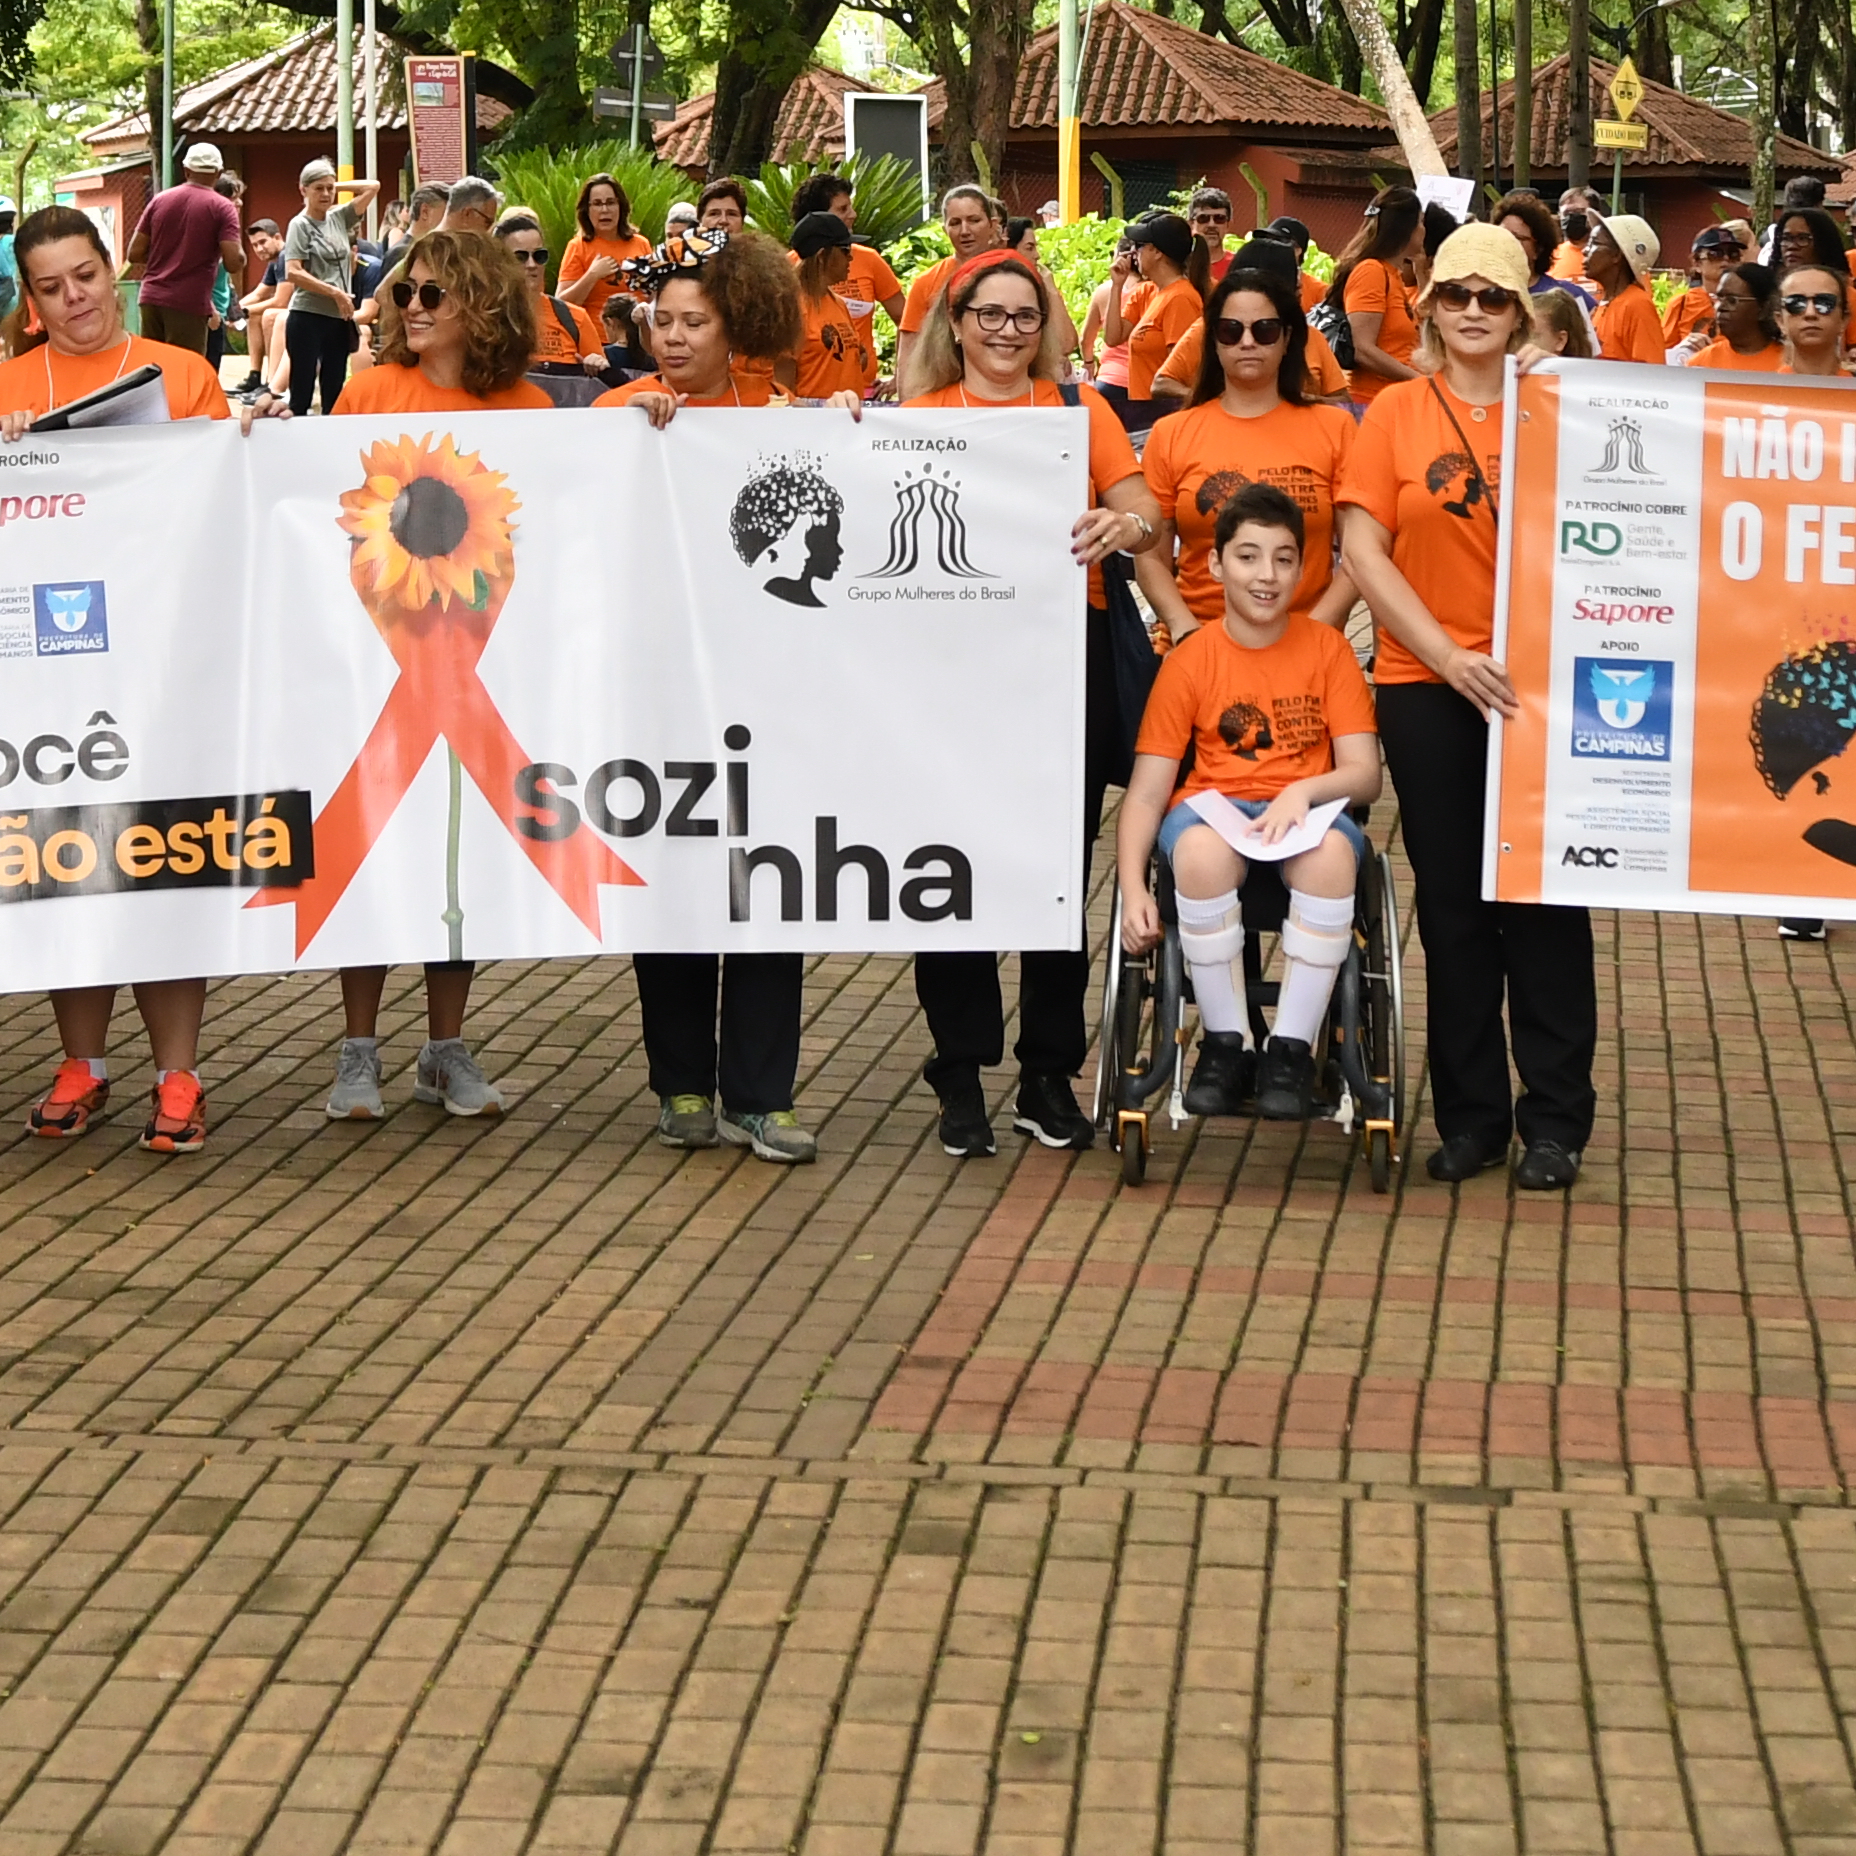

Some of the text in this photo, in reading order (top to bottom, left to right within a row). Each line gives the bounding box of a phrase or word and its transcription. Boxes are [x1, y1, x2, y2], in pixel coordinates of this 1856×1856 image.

[1588, 397, 1669, 410] REALIZAÇÃO
[872, 436, 967, 454] REALIZAÇÃO
[1721, 403, 1823, 482] NÃO
[1258, 467, 1290, 476] PELO
[1566, 500, 1688, 516] PATROCÍNIO COBRE
[1561, 520, 1623, 556] RD
[1721, 500, 1764, 581] O
[848, 586, 1016, 602] Grupo Mulheres do Brasil
[1584, 584, 1662, 598] PATROCÍNIO
[1572, 598, 1674, 627] Sapore
[40, 638, 104, 652] CAMPINAS
[1600, 640, 1640, 652] APOIO
[1272, 696, 1302, 708] PELO
[1276, 716, 1325, 731] CONTRA
[1574, 738, 1666, 756] CAMPINAS
[514, 724, 752, 841] sozi
[115, 799, 293, 880] está
[1562, 846, 1619, 868] ACIC
[729, 816, 973, 923] nha
